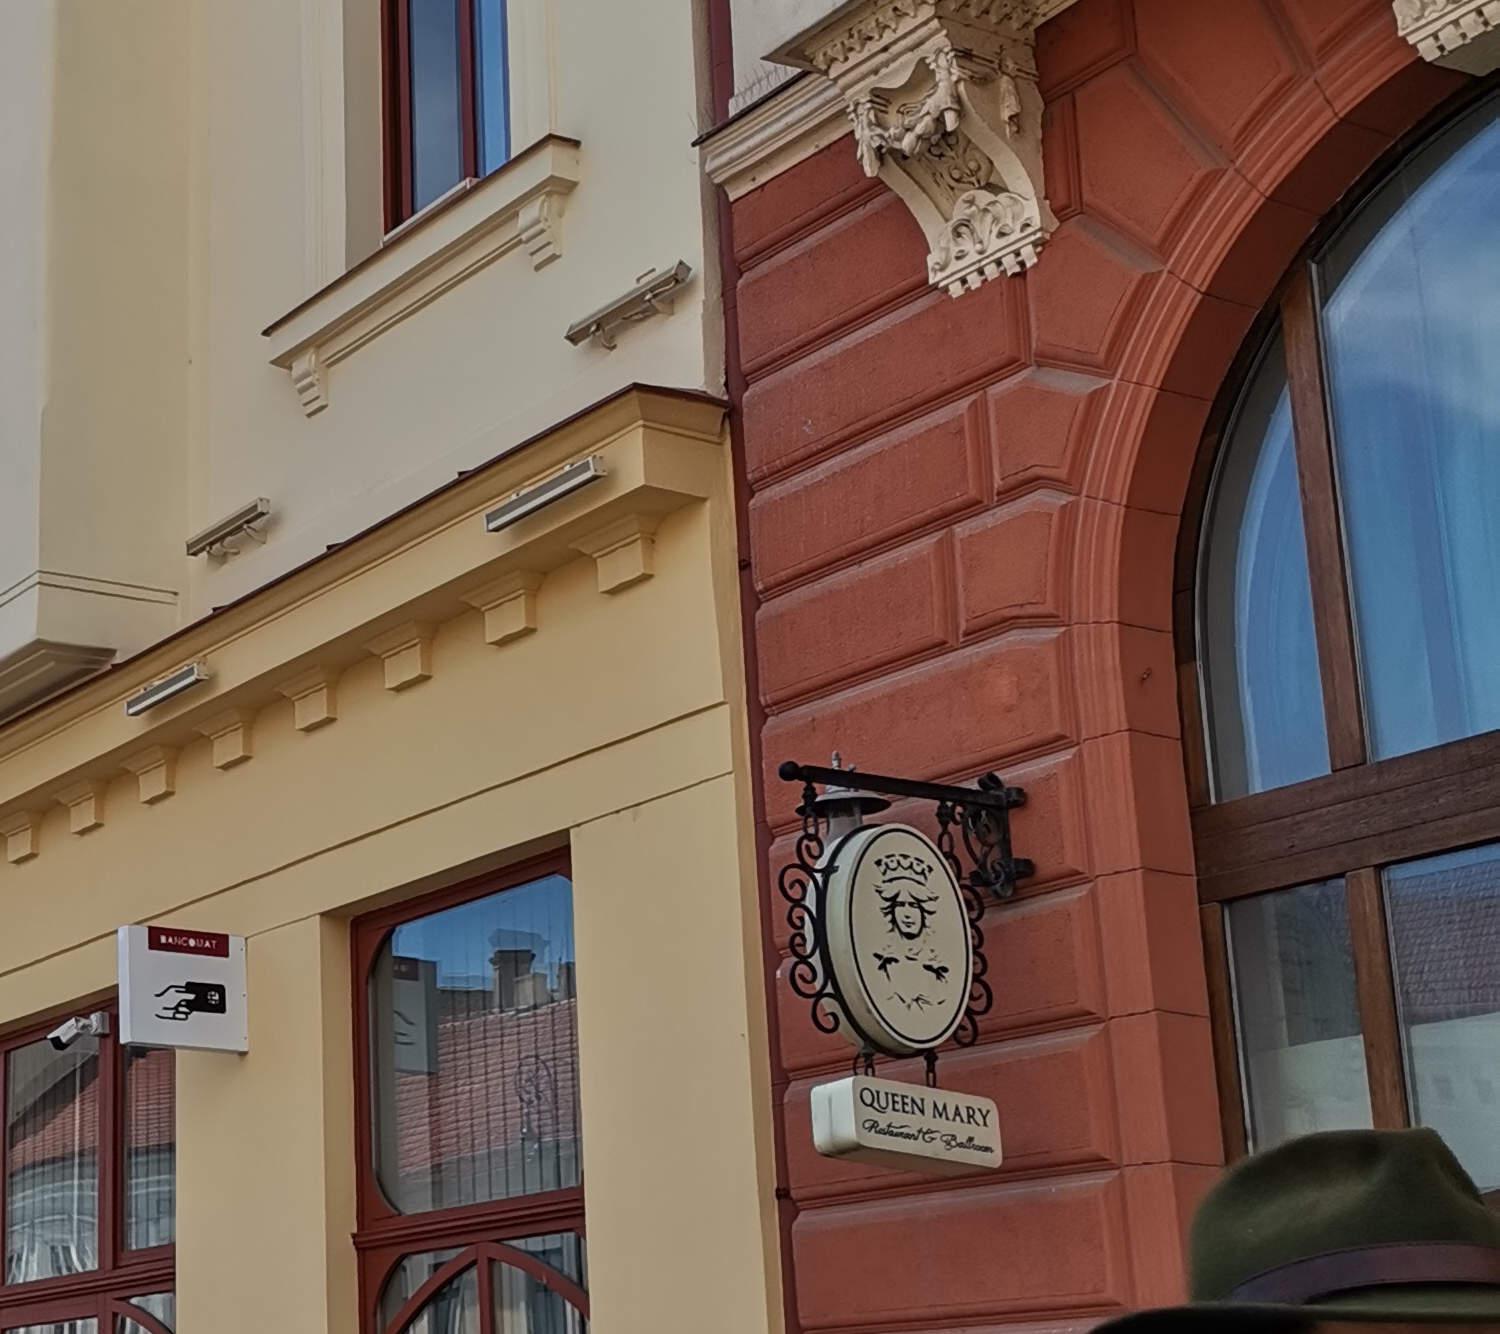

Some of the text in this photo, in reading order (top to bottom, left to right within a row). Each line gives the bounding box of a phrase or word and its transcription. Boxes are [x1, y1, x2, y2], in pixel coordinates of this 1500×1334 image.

[160, 934, 218, 950] BANCOMAT
[860, 1087, 991, 1128] QUEEN MARY
[862, 1118, 921, 1142] Restaurant
[940, 1133, 995, 1154] Ballroom
